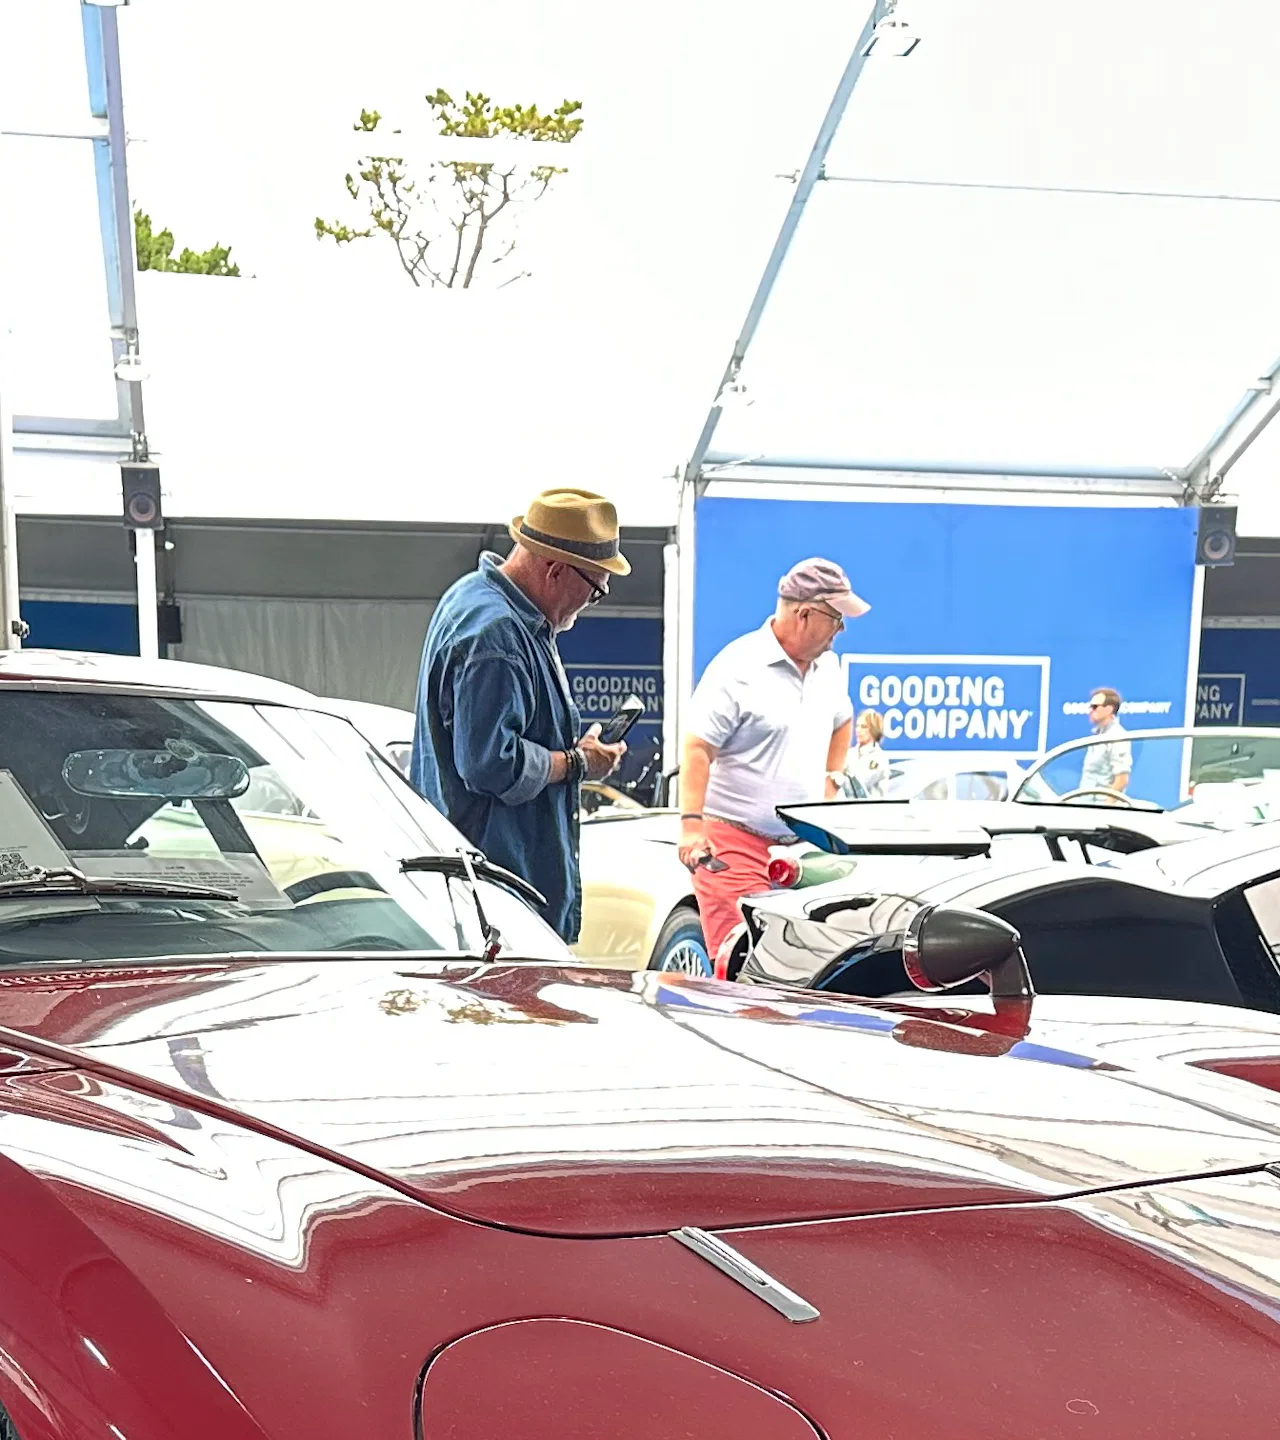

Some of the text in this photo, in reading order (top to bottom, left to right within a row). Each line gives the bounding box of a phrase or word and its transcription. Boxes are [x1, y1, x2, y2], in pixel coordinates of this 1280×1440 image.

[572, 675, 657, 694] GOODING
[859, 674, 1005, 707] GOODING
[870, 707, 1029, 740] COMPANY
